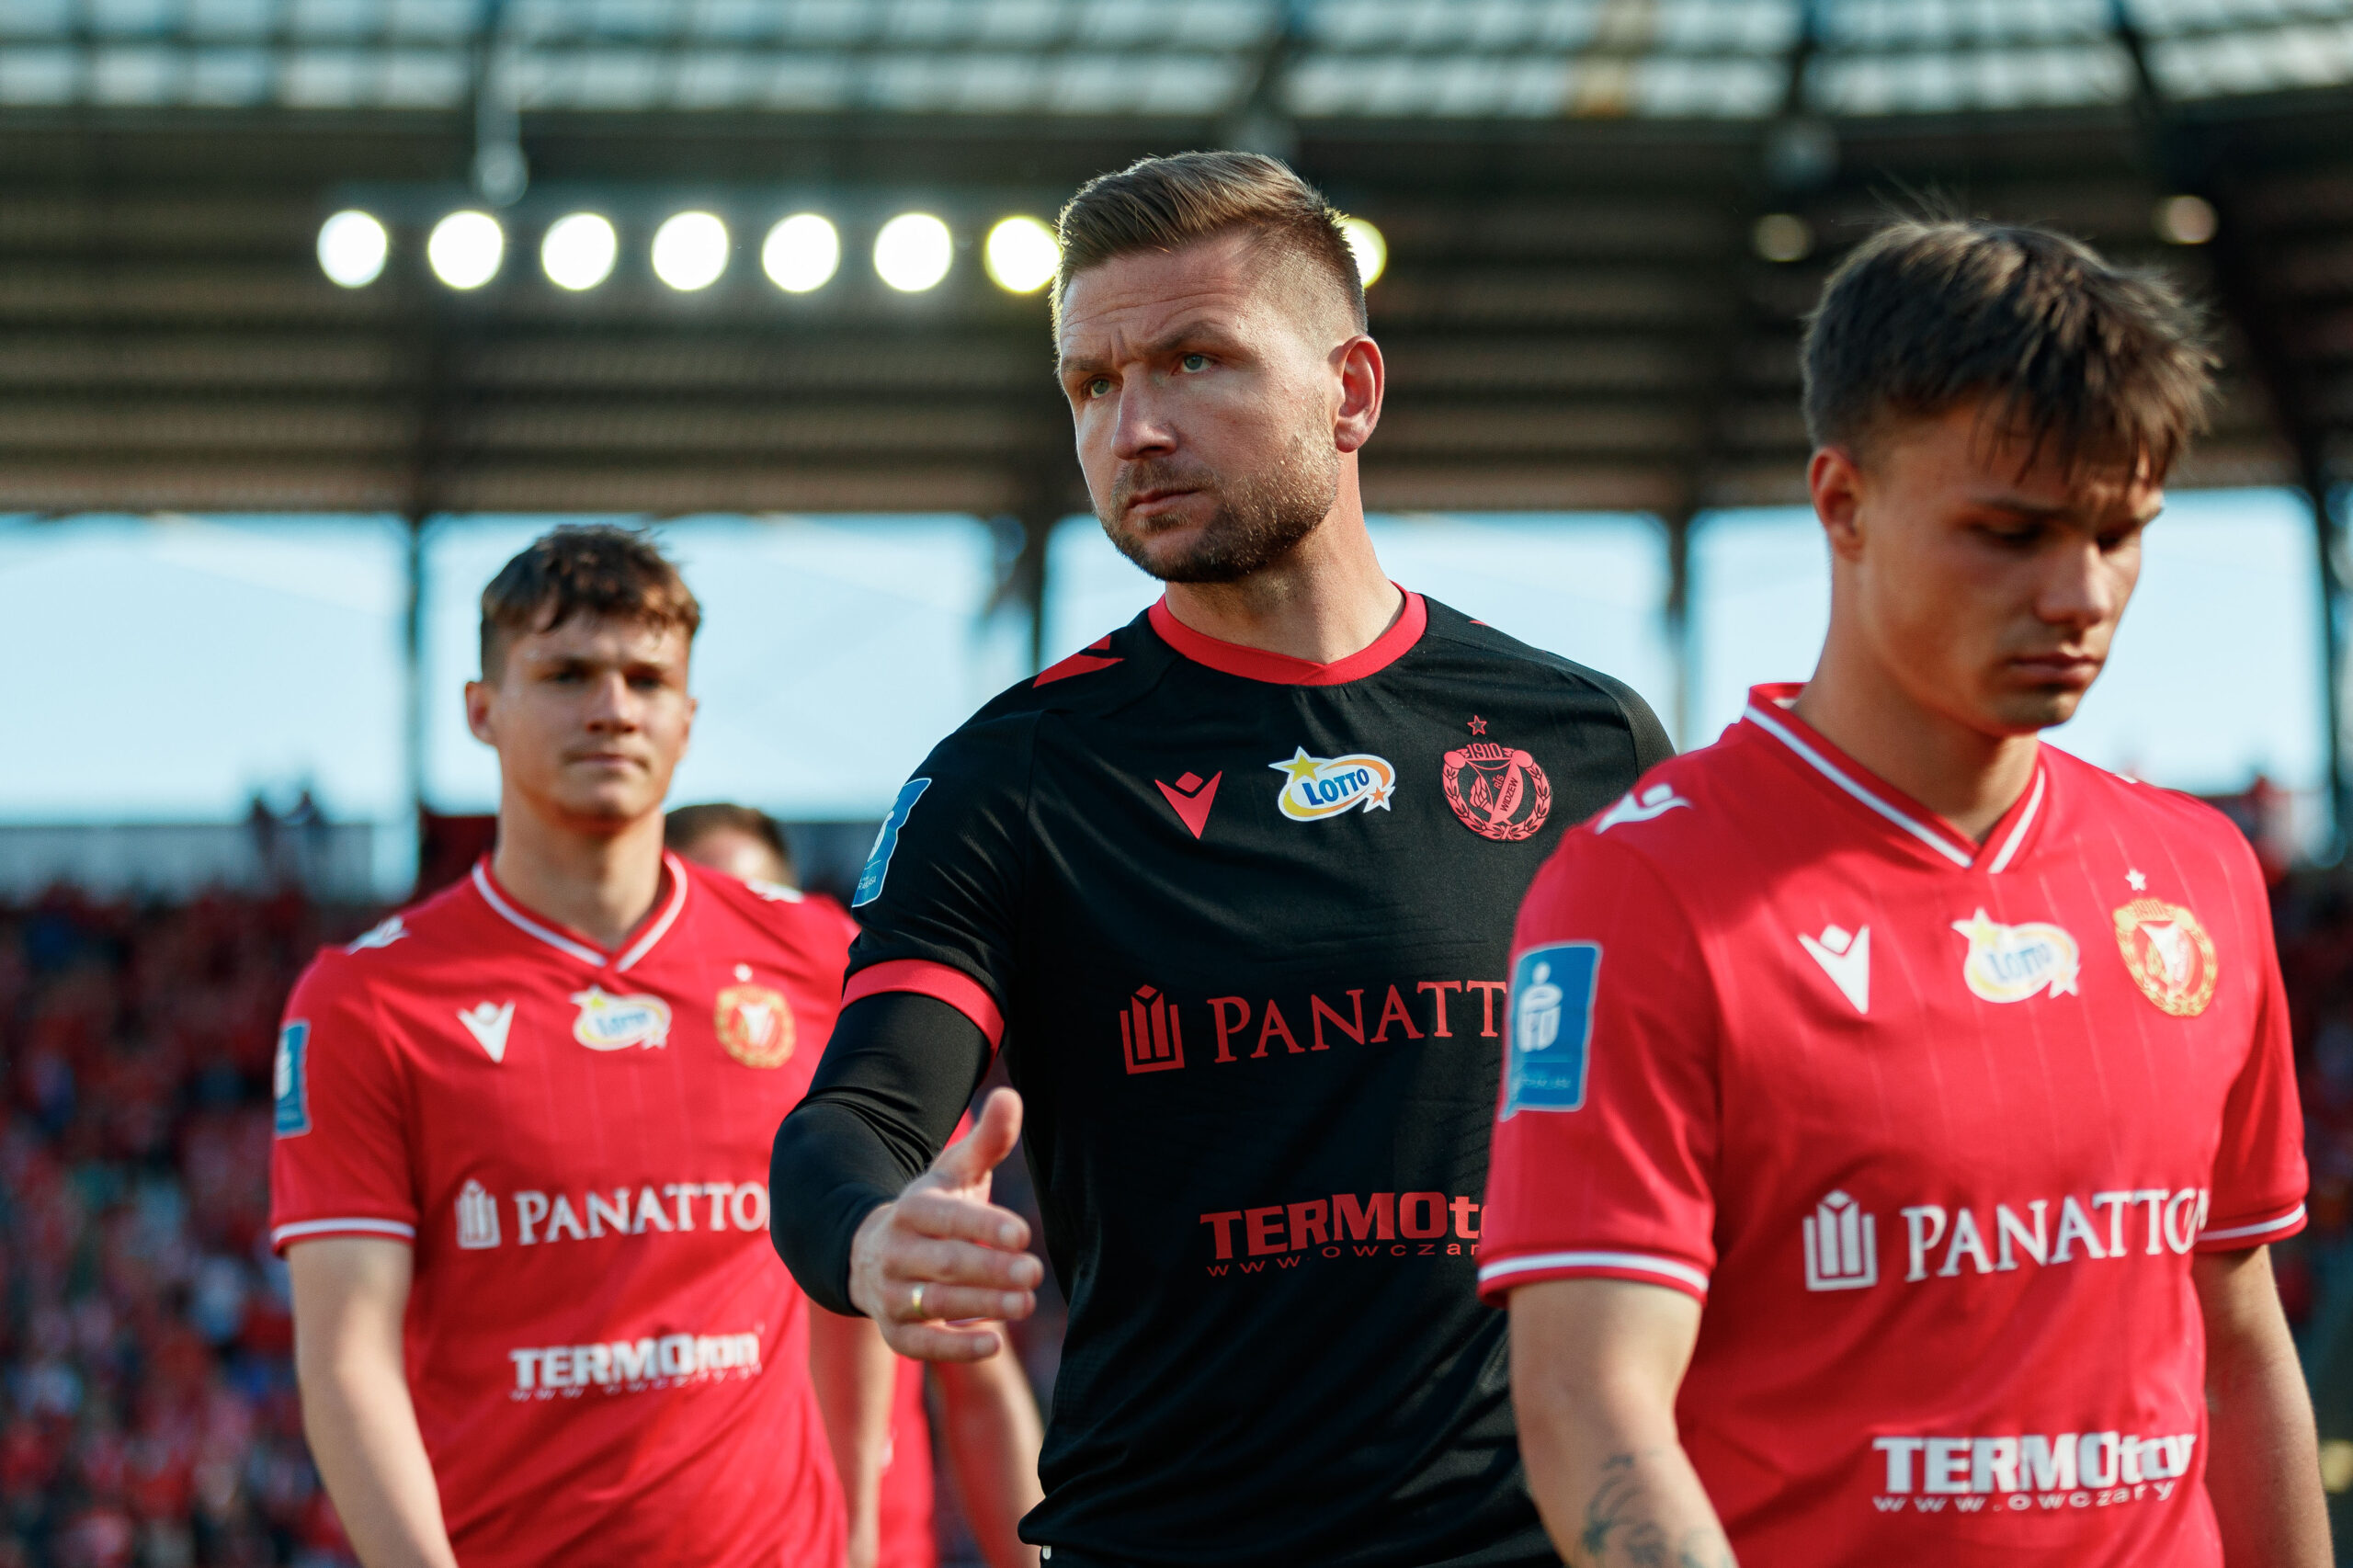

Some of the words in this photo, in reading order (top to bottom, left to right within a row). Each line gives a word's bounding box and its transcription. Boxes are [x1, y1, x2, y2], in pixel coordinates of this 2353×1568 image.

[1467, 743, 1503, 760] 1910
[1302, 767, 1370, 806] LOTTO
[1500, 778, 1519, 812] WIDZEW
[513, 1180, 770, 1246] PANATTO
[1199, 1191, 1489, 1260] TERMOt
